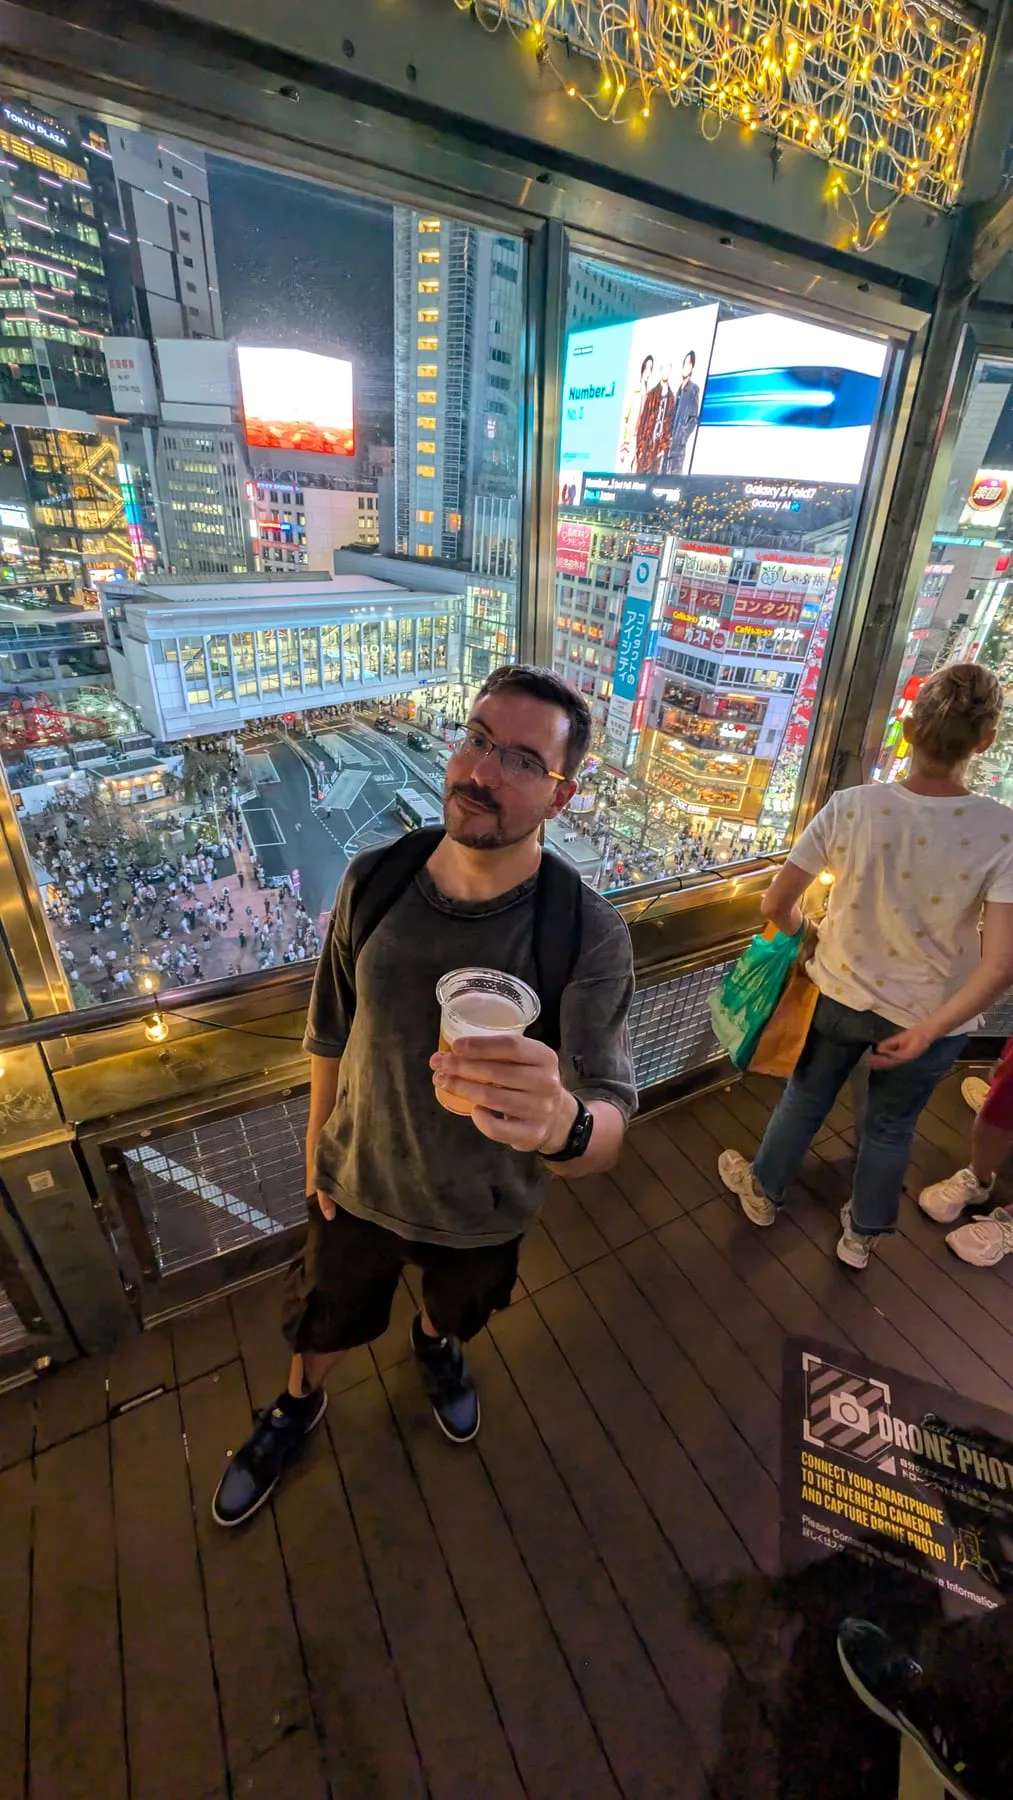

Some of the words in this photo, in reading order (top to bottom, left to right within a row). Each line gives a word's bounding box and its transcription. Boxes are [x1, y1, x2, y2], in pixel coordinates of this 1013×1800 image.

[4, 109, 36, 131] TOKYU
[36, 125, 67, 147] PLAZA
[568, 381, 616, 401] Number_i
[745, 484, 780, 499] Galaxy
[779, 486, 788, 498] Z
[788, 487, 817, 499] Fold7
[752, 498, 781, 512] Galaxy
[735, 599, 799, 621] コンタクト
[618, 610, 637, 682] アイシティ
[627, 613, 645, 685] コンタクトの
[684, 627, 711, 646] ガスト
[772, 627, 805, 643] ガスト
[878, 1411, 956, 1470] DRONE
[801, 1451, 846, 1482] CONNECT
[847, 1470, 874, 1495] YOUR
[874, 1483, 945, 1526] SMARTPHONE
[802, 1468, 814, 1486] TO
[815, 1473, 834, 1494] THE
[835, 1482, 888, 1517] OVERHEAD
[888, 1506, 933, 1538] CAMERA
[801, 1485, 823, 1505] AND
[823, 1494, 870, 1527] CAPTURE
[870, 1515, 905, 1542] DRONE
[906, 1530, 947, 1563] PHOTO!
[802, 1513, 831, 1535] Please
